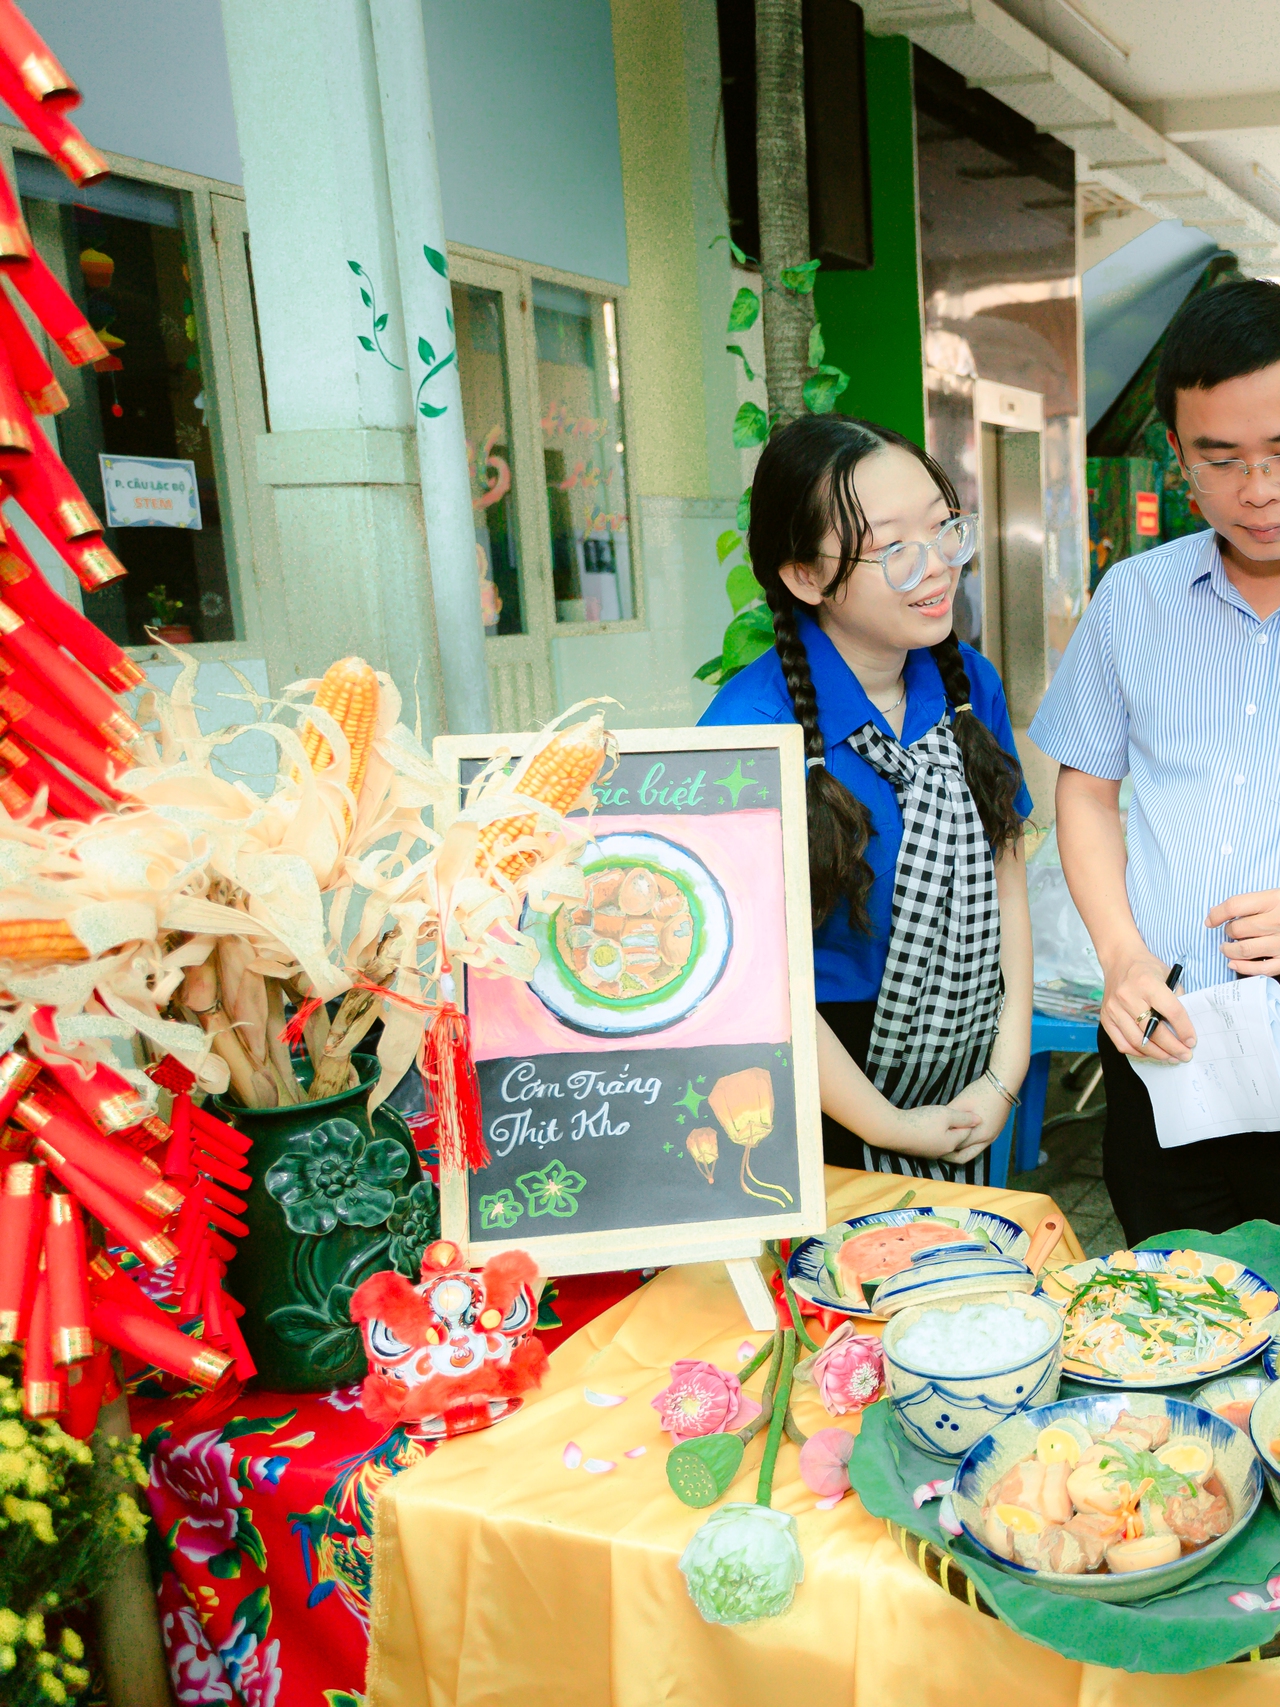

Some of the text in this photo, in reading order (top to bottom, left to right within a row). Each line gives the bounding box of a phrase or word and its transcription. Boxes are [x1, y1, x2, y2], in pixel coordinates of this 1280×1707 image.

[115, 478, 186, 495] P. CÂU LẠC BỘ
[135, 497, 173, 511] STEM
[638, 761, 707, 811] biệt
[501, 1062, 663, 1105] Cơm Trắng
[489, 1101, 631, 1157] Thịt Kho
